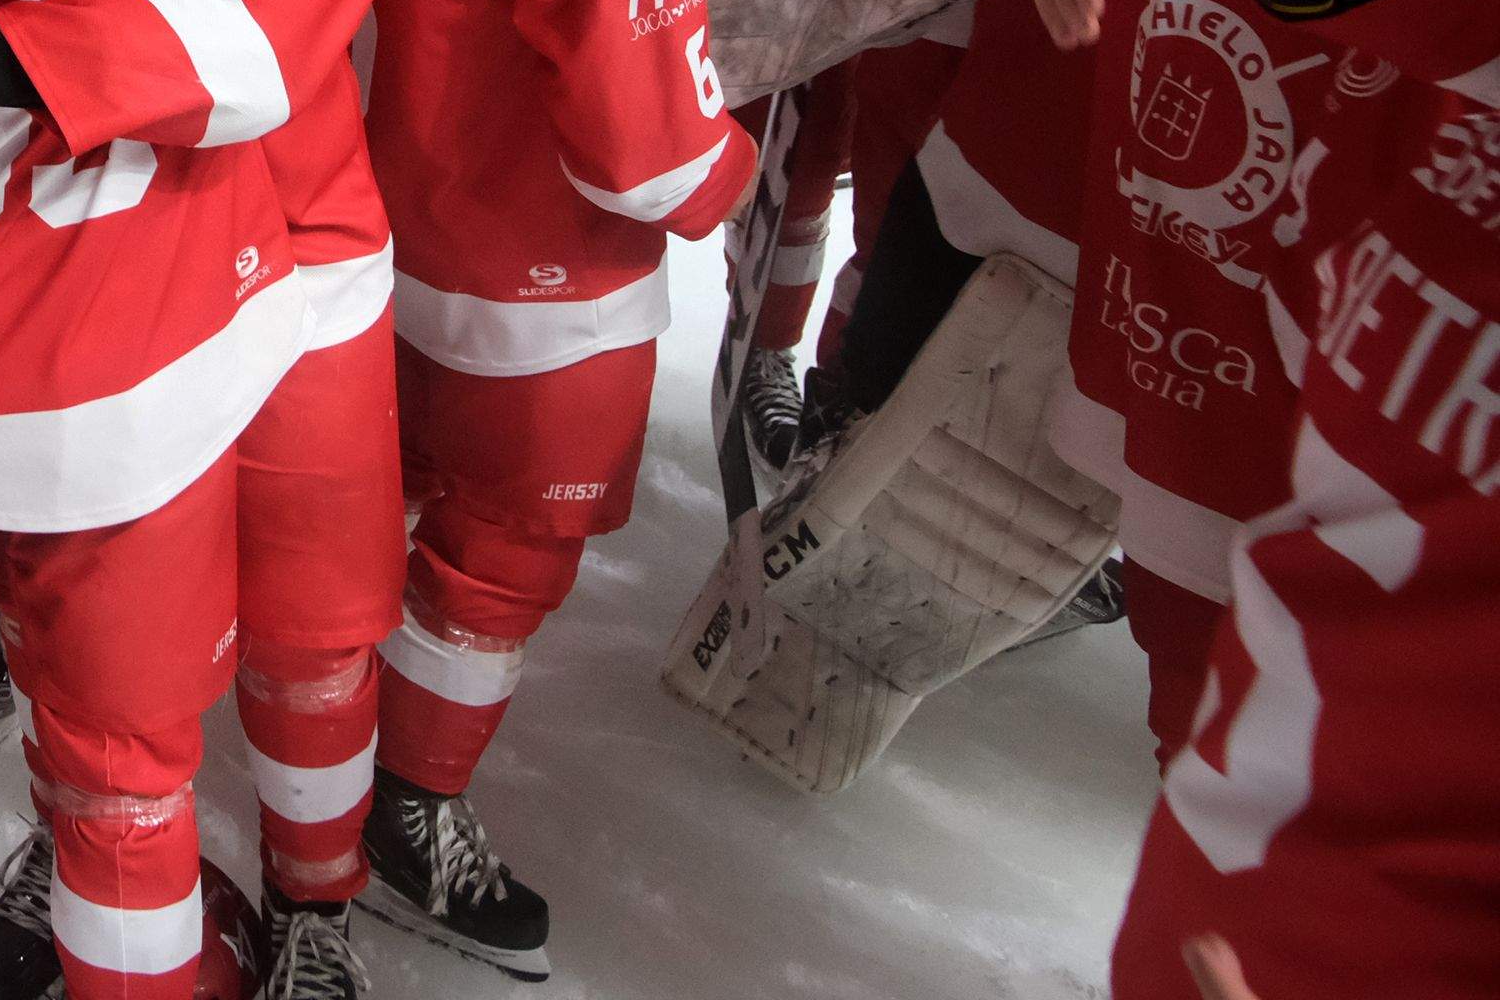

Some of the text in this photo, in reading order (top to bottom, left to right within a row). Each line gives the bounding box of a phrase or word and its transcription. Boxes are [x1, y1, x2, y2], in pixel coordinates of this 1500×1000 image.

[684, 24, 725, 120] 6
[1152, 1, 1265, 81] HIELO
[1221, 107, 1286, 213] JACA
